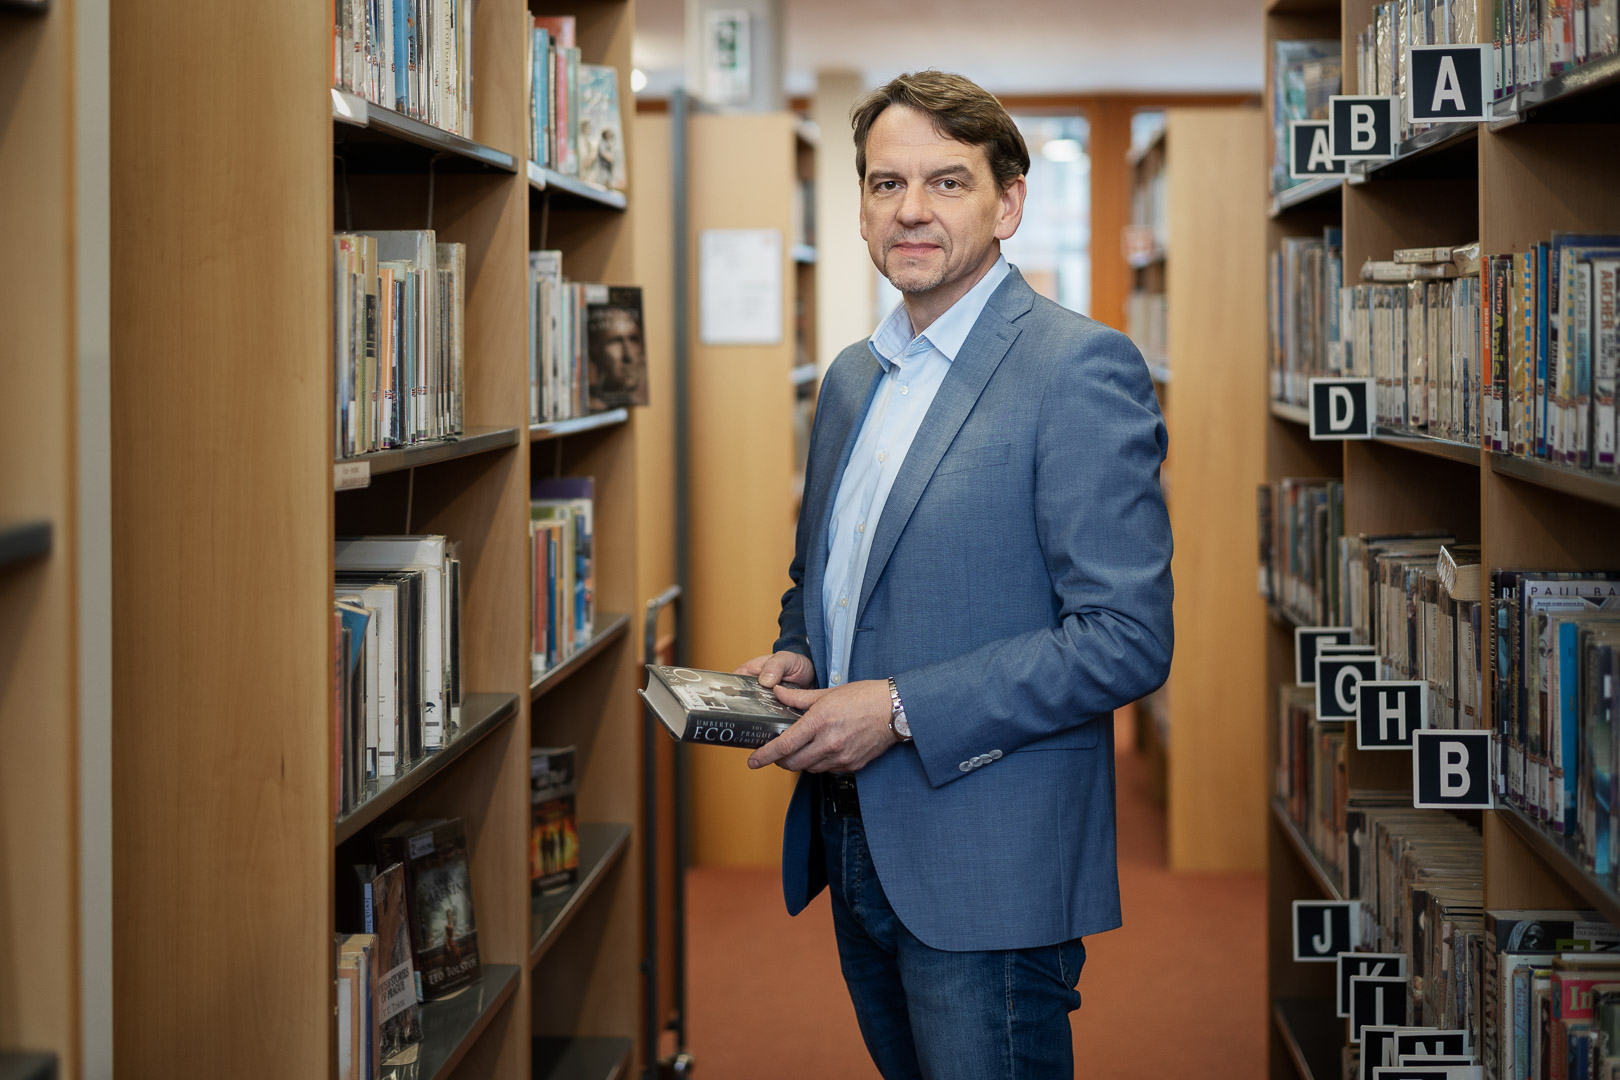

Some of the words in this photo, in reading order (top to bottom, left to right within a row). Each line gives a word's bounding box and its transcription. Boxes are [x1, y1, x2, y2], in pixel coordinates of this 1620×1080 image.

[1431, 55, 1466, 112] A
[1307, 128, 1334, 171] A
[1350, 104, 1377, 151] B
[1495, 275, 1504, 314] Martin
[1577, 270, 1586, 328] ARCHER
[1600, 269, 1614, 330] ARCHER
[1493, 312, 1504, 376] Amis
[1328, 386, 1354, 431] D
[1530, 586, 1580, 596] PAUL
[1334, 664, 1363, 714] G
[693, 726, 735, 743] ECO
[696, 719, 736, 729] UMBERTO
[740, 730, 772, 739] PRAGUE
[1378, 690, 1406, 741] H
[1439, 741, 1471, 798] B
[364, 896, 373, 919] Jewish
[1312, 908, 1332, 954] J
[428, 972, 445, 985] LEO
